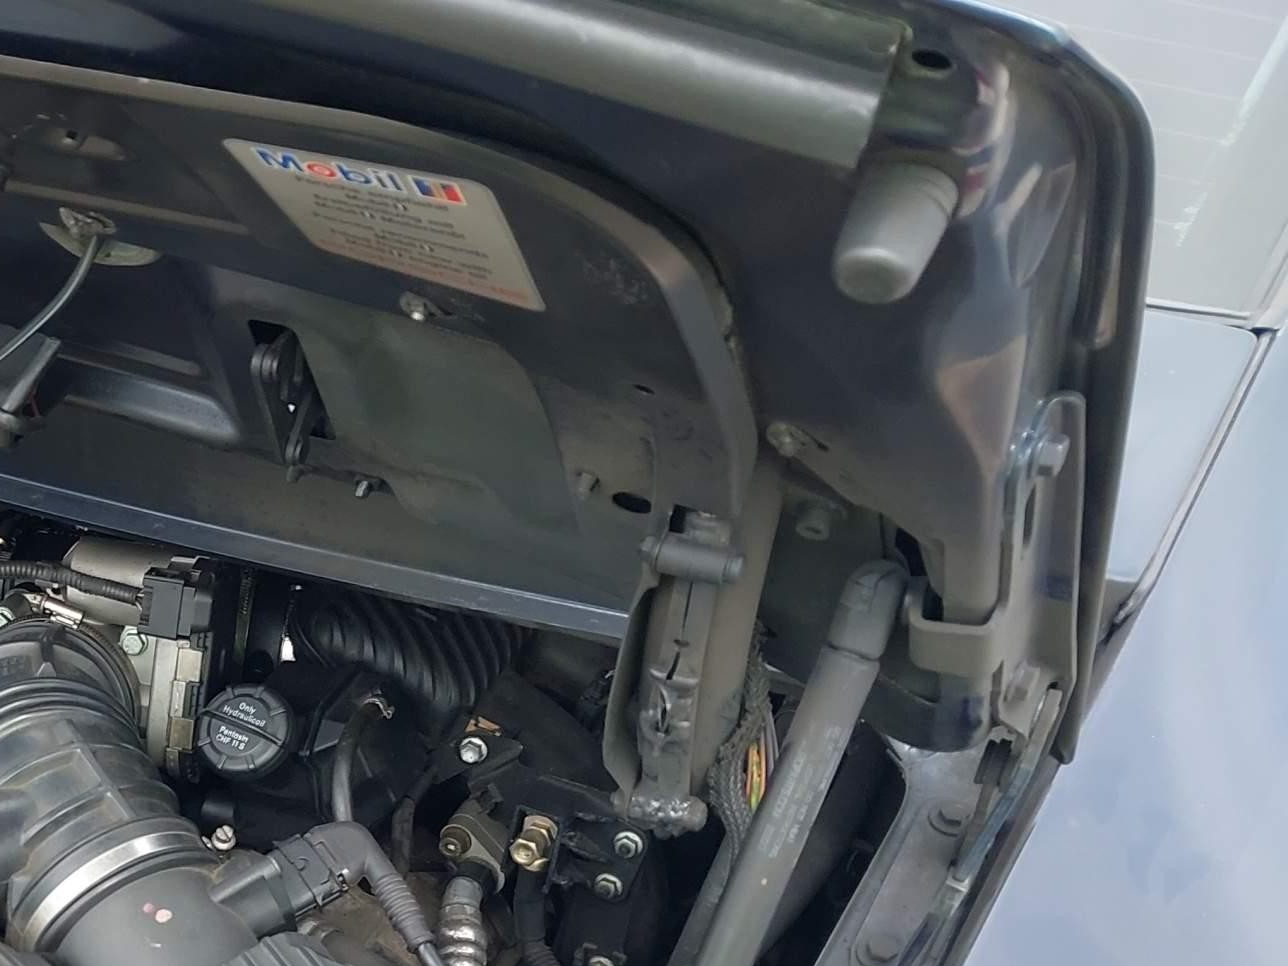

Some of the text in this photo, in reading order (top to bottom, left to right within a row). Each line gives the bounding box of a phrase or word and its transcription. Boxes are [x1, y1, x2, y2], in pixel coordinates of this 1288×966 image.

[256, 148, 404, 191] Mobil
[239, 702, 256, 714] Only
[220, 726, 248, 742] Pentosin
